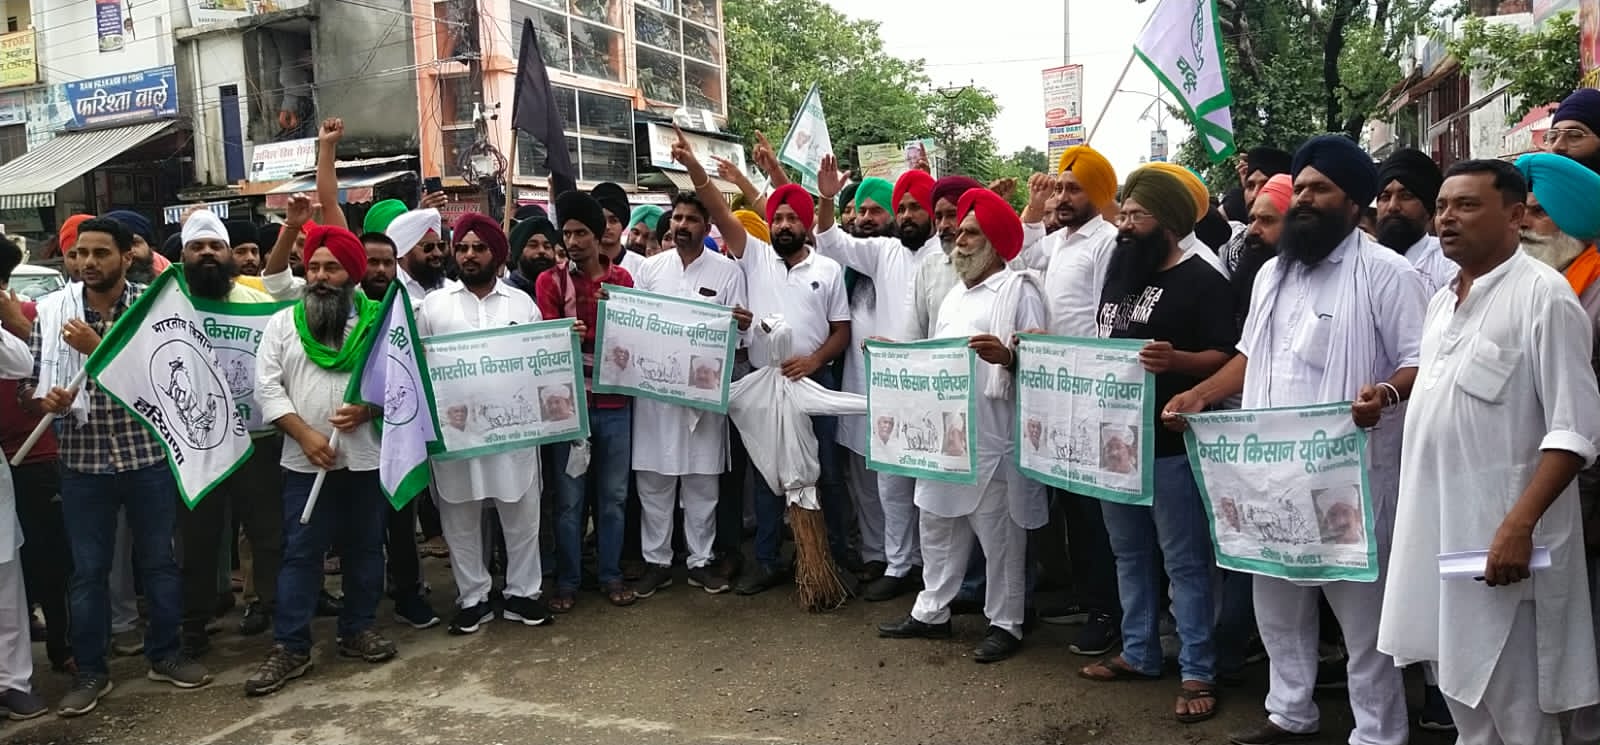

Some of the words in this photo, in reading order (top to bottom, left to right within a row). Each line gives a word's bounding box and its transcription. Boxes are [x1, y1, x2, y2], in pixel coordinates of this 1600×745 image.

[76, 89, 133, 116] फरिश्ता
[135, 78, 169, 112] वाले
[152, 313, 187, 333] भारतीय
[203, 317, 253, 342] किसान
[606, 308, 645, 331] भारतीय
[646, 312, 684, 337] किसान
[686, 322, 728, 346] यूनियन
[431, 358, 477, 381] भारतीय
[480, 355, 524, 376] किसान
[527, 348, 572, 376] यूनियन
[931, 369, 969, 400] यूनियन
[1057, 367, 1094, 396] किसान
[1095, 373, 1144, 408] यूनियन
[133, 397, 185, 465] हरियाणा
[1243, 434, 1297, 463] किसान
[1299, 430, 1359, 474] यूनियन
